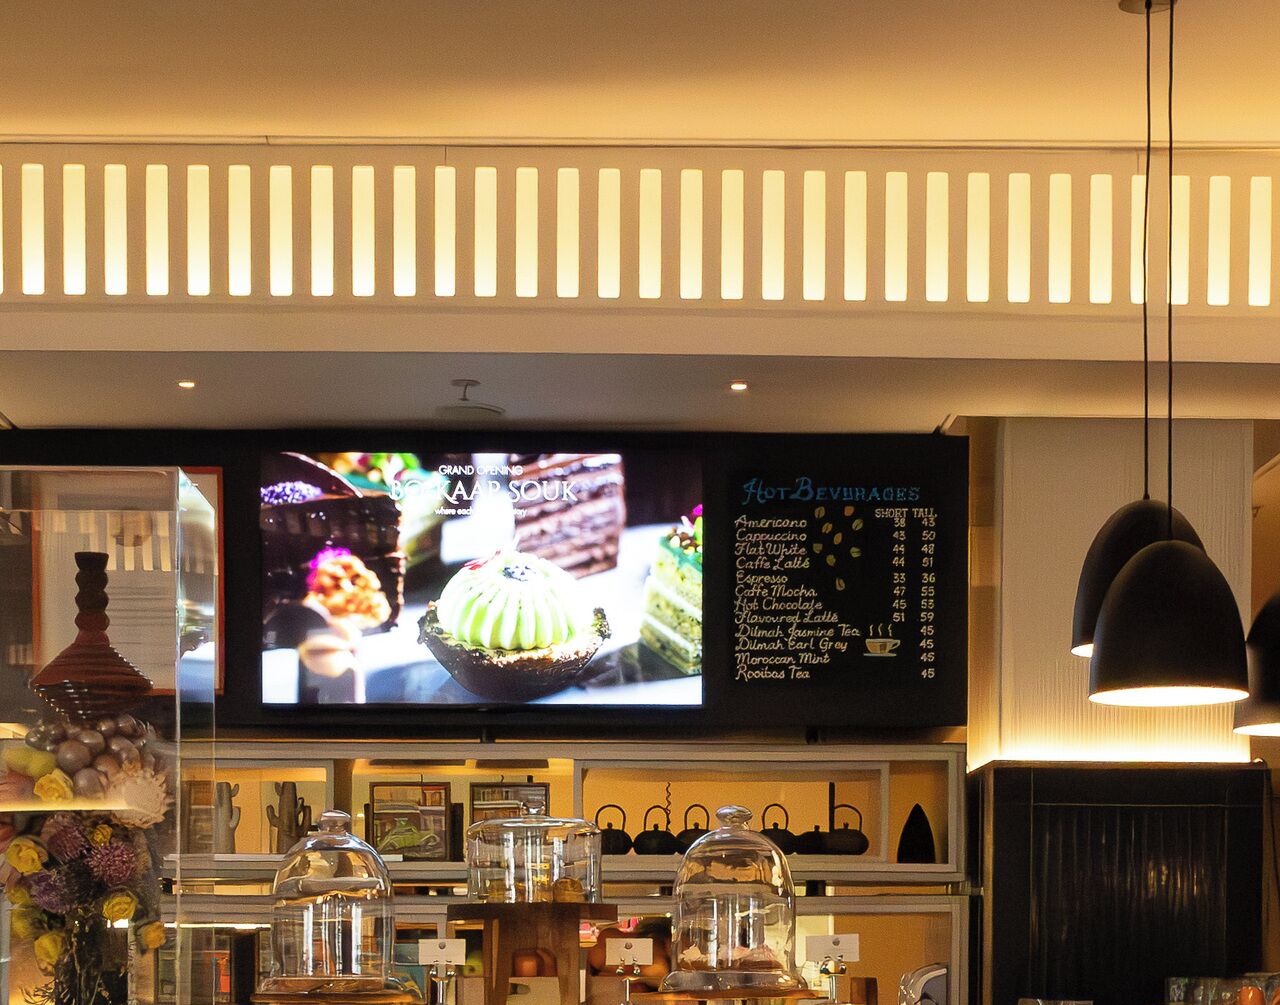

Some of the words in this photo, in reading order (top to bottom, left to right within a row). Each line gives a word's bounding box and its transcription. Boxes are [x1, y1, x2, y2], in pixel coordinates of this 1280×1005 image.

[438, 464, 475, 476] GRAND
[476, 464, 524, 476] OPENING
[508, 480, 579, 502] SOUK
[874, 508, 908, 518] SHORT
[912, 508, 938, 518] TALL
[734, 514, 807, 528] Americano
[921, 518, 936, 527] 43
[736, 528, 807, 543] Cappuccino
[892, 531, 906, 540] 43
[921, 530, 936, 540] 50
[734, 541, 765, 556] Flat
[766, 542, 808, 557] White
[892, 557, 905, 567] 44
[736, 570, 789, 585] Espresso
[893, 573, 906, 583] 33
[922, 572, 936, 583] 36
[771, 584, 818, 597] Mocha
[893, 586, 906, 596] 47
[921, 586, 935, 596] 55
[734, 597, 759, 611] Hot
[762, 597, 823, 610] Chocolate
[892, 599, 907, 610] 45
[921, 599, 935, 609] 53
[734, 611, 801, 624] Flavoured
[892, 612, 905, 622] 51
[920, 612, 935, 622] 59
[735, 623, 784, 638] Dilmah
[787, 623, 835, 640] Jasmine
[838, 623, 861, 637] Tea
[920, 625, 935, 636] 45
[735, 637, 784, 651] Dilmah
[786, 637, 815, 650] Earl
[819, 637, 848, 652] Grey
[920, 639, 934, 649] 45
[735, 652, 796, 665] Moroccan
[798, 652, 831, 664] Mint
[920, 652, 935, 662] 45
[788, 665, 811, 680] Tea
[921, 668, 935, 679] 45
